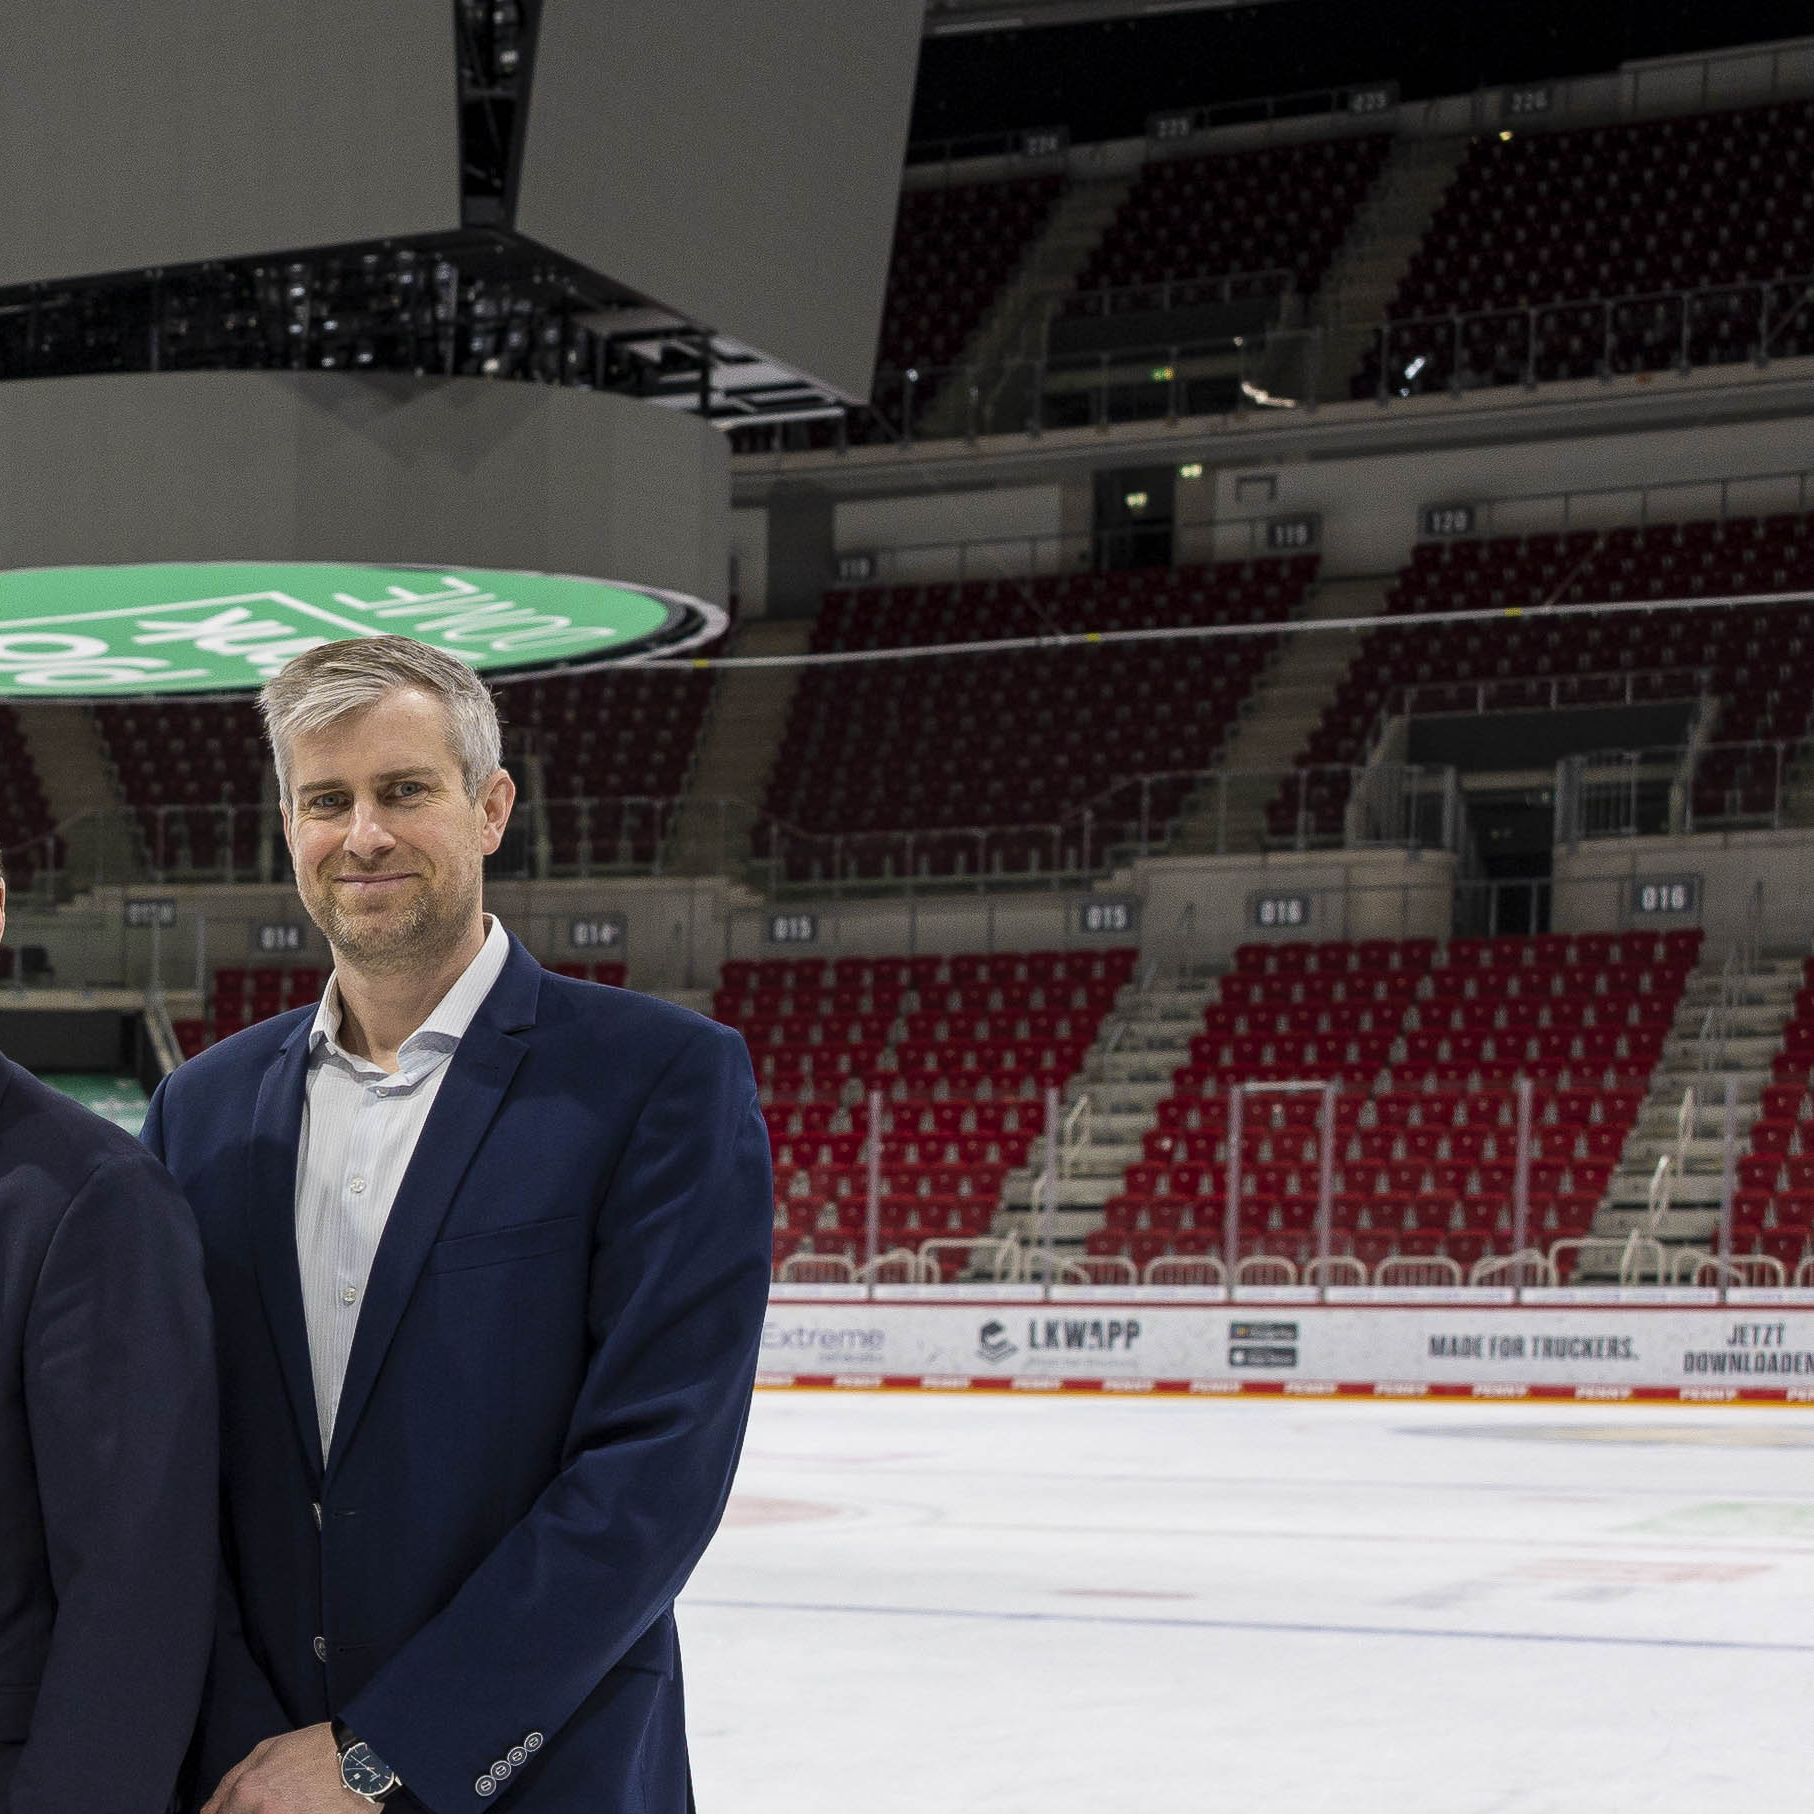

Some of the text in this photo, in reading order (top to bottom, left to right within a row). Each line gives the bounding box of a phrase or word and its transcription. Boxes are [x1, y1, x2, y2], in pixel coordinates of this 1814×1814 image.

[1641, 884, 1686, 912] 016
[762, 1322, 885, 1350] Extreme
[1430, 1336, 1484, 1359] MADE
[1488, 1336, 1526, 1359] FOR
[1728, 1323, 1786, 1347] JETZT
